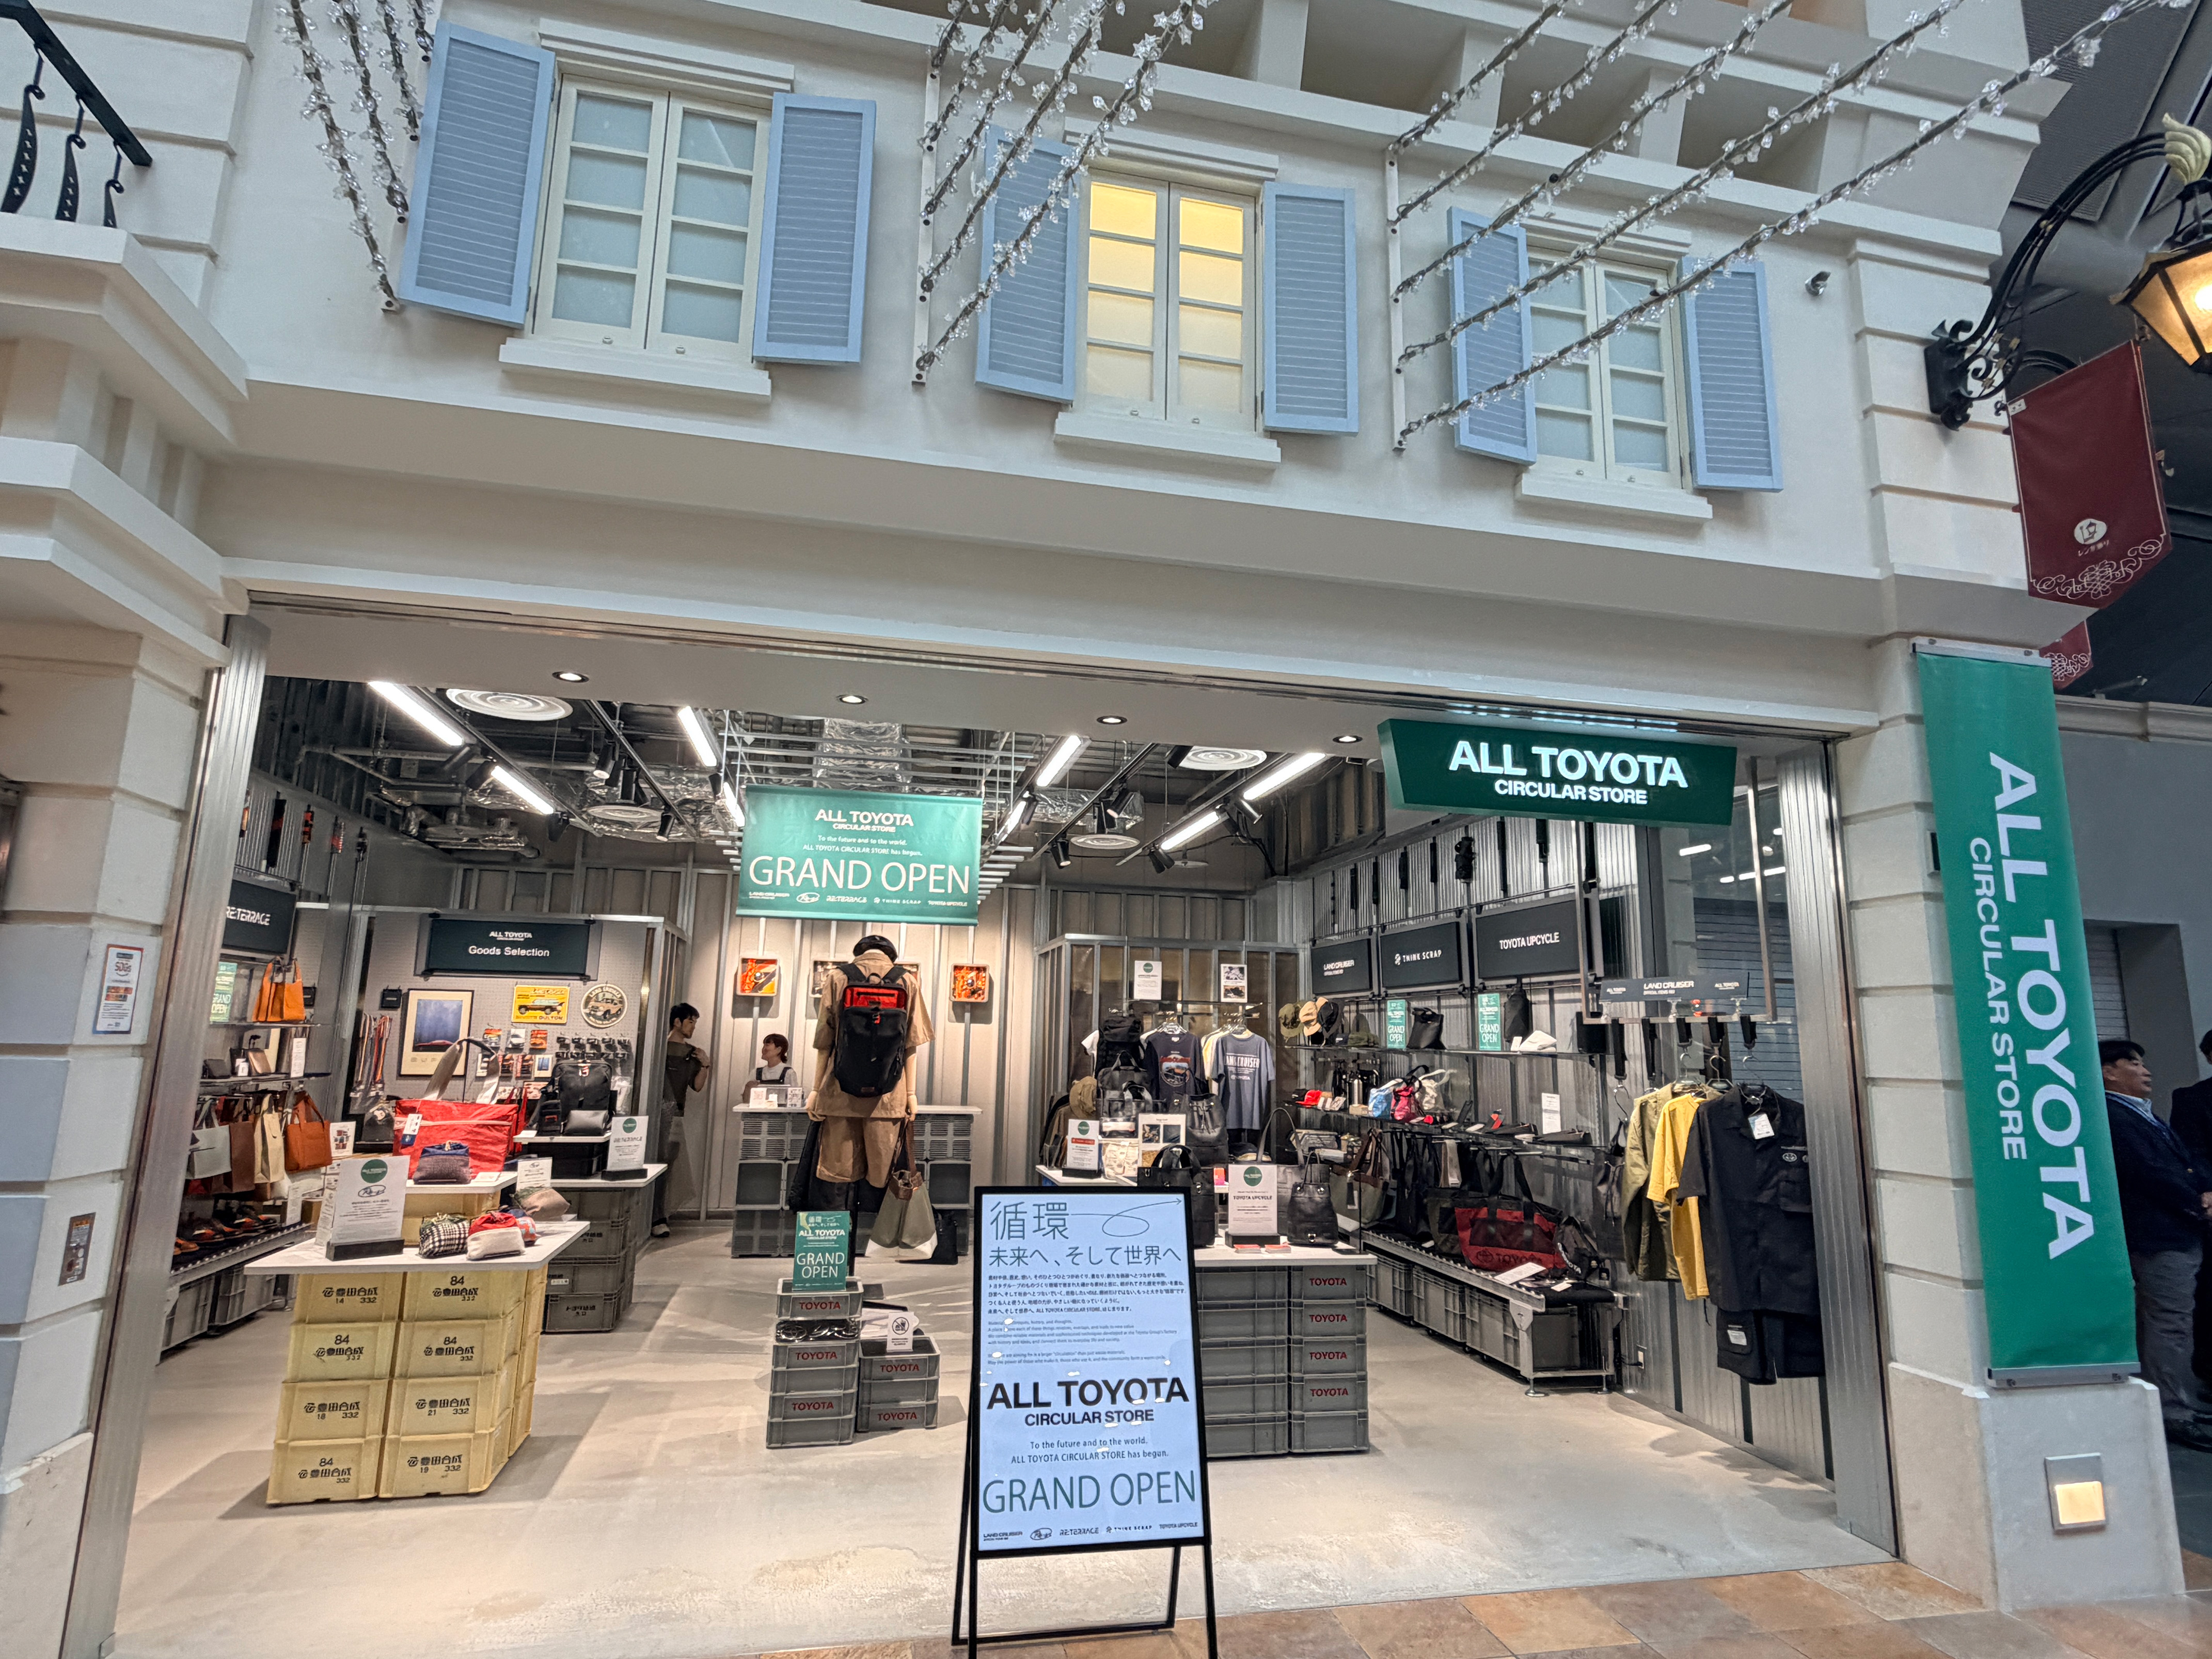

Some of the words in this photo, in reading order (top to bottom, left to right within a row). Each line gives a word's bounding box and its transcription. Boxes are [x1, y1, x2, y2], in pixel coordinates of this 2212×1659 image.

[1449, 740, 1527, 777] ALL
[1531, 746, 1688, 788] TOYOTA
[1494, 779, 1587, 801] CIRCULAR
[1588, 786, 1648, 805] STORE
[815, 809, 847, 823] ALL
[849, 810, 914, 827] TOYOTA
[832, 823, 871, 831] CIRCULAR
[871, 825, 896, 833] STORE
[1989, 752, 2048, 903] ALL
[841, 845, 870, 854] CIRCULAR
[749, 855, 872, 890] GRAND
[881, 861, 970, 894] OPEN
[1499, 937, 1526, 950] TOYOTA
[1526, 931, 1560, 946] UPCYCLE
[468, 945, 501, 955] Goods
[504, 946, 550, 957] Selection
[1422, 949, 1442, 960] SCRAP
[1663, 980, 1695, 989] CRUISER
[1969, 836, 2011, 1025] CIRCULAR
[1992, 1032, 2028, 1161] STORE
[1387, 1025, 1405, 1034] GRAND
[1479, 1023, 1499, 1033] GRAND
[1389, 1033, 1403, 1042] OPEN
[1481, 1034, 1497, 1043] OPEN
[2011, 919, 2095, 1260] TOYOTA
[990, 1201, 1070, 1240] 循環
[797, 1252, 845, 1265] GRAND
[989, 1245, 1181, 1267] 未来へ、そして世界へ
[802, 1266, 838, 1278] OPEN
[450, 1275, 464, 1286] 84
[1309, 1277, 1348, 1286] TOYOTA
[798, 1301, 841, 1310] TOYOTA
[1309, 1314, 1348, 1323] TOYOTA
[335, 1334, 350, 1346] 84
[444, 1336, 457, 1346] 84
[796, 1351, 838, 1361] TOYOTA
[1309, 1351, 1348, 1360] TOYOTA
[880, 1363, 920, 1373] TOYOTA
[986, 1382, 1052, 1410] ALL
[1057, 1377, 1190, 1408] TOYOTA
[1309, 1387, 1349, 1397] TOYOTA
[792, 1401, 834, 1412] TOYOTA
[878, 1412, 918, 1421] TOYOTA
[1024, 1411, 1102, 1427] CIRCULAR
[1104, 1409, 1155, 1423] STORE
[1030, 1441, 1039, 1449] To
[1042, 1441, 1054, 1449] the
[1057, 1440, 1081, 1448] future
[1124, 1436, 1148, 1445] world.
[319, 1458, 334, 1467] 84
[1011, 1456, 1025, 1464] ALL
[1028, 1454, 1059, 1463] TOYOTA
[1062, 1452, 1099, 1462] CIRCULAR
[1101, 1451, 1126, 1460] STORE
[1143, 1450, 1168, 1459] begun.
[983, 1475, 1100, 1513] GRAND
[1111, 1470, 1195, 1506] OPEN
